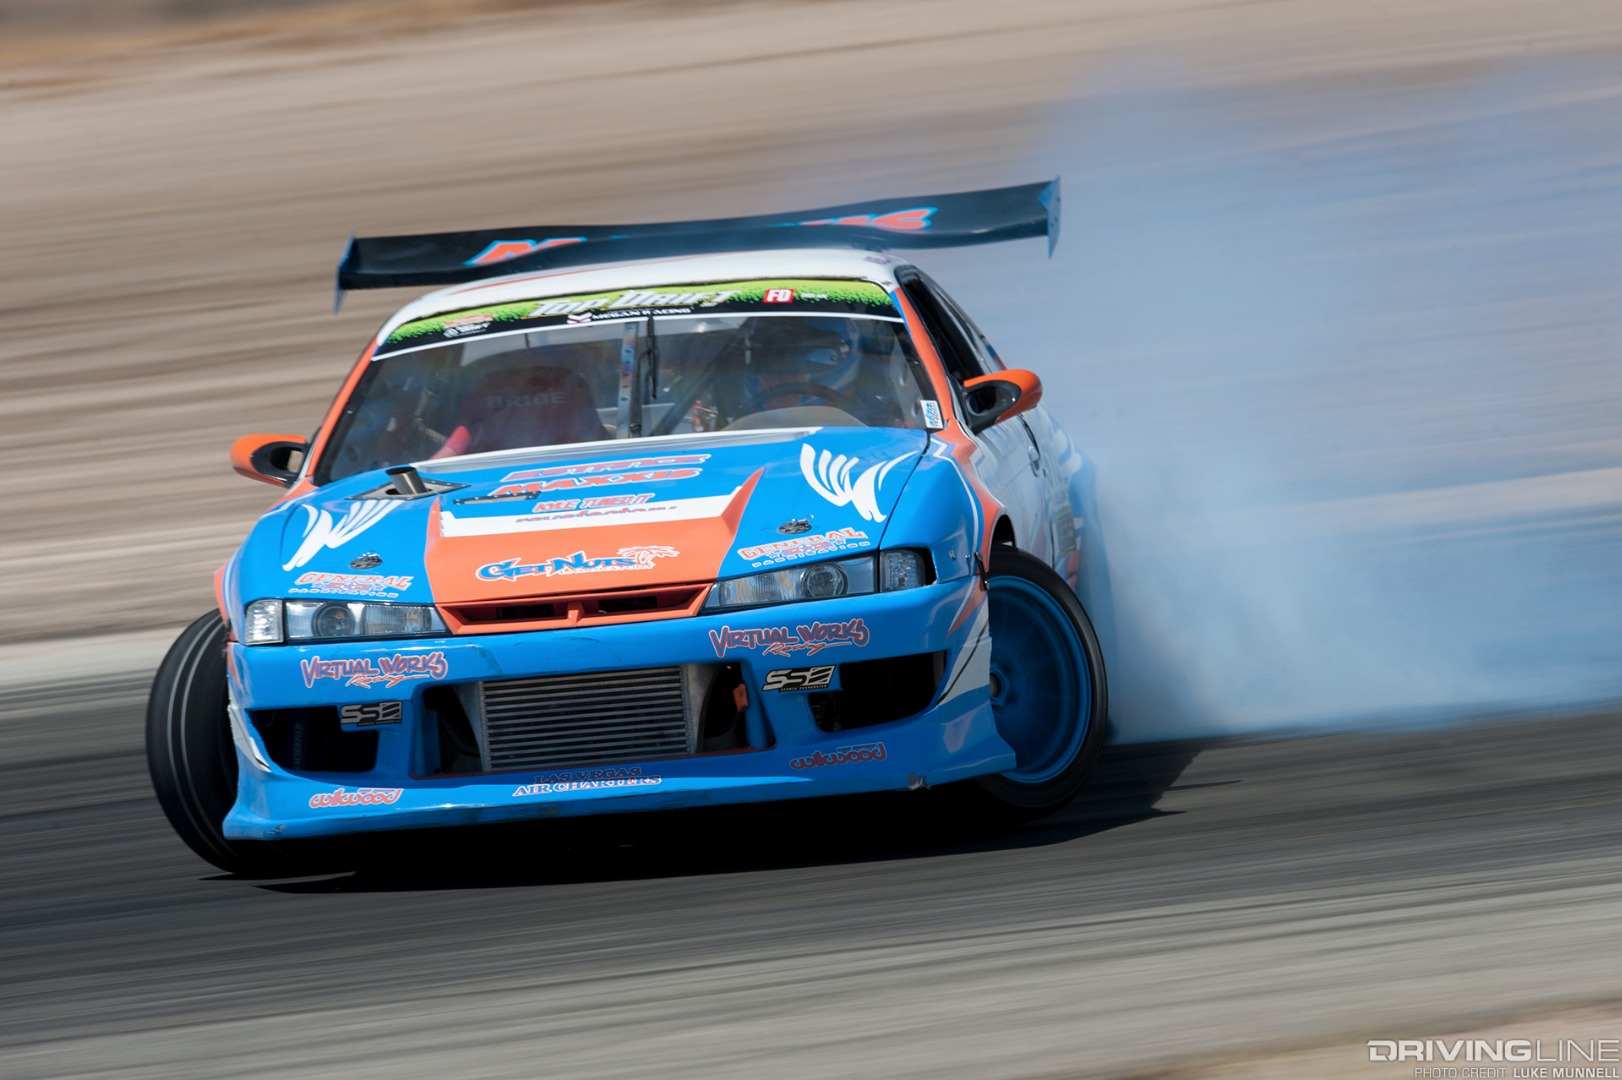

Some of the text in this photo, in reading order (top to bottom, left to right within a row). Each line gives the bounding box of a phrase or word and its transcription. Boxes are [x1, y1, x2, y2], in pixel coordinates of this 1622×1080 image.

[527, 289, 742, 317] TOP DRIFT
[488, 468, 702, 496] MAXXIS
[737, 527, 868, 560] GENERAL
[294, 572, 414, 591] GENERAL
[709, 619, 870, 658] VIRTUAL WORKS
[763, 642, 852, 657] Racing
[301, 652, 448, 688] VIRTUAL WORKS
[789, 741, 887, 770] wilwood
[534, 767, 641, 784] LAS VEGAS
[309, 787, 404, 809] wilwood
[512, 783, 552, 797] AIR
